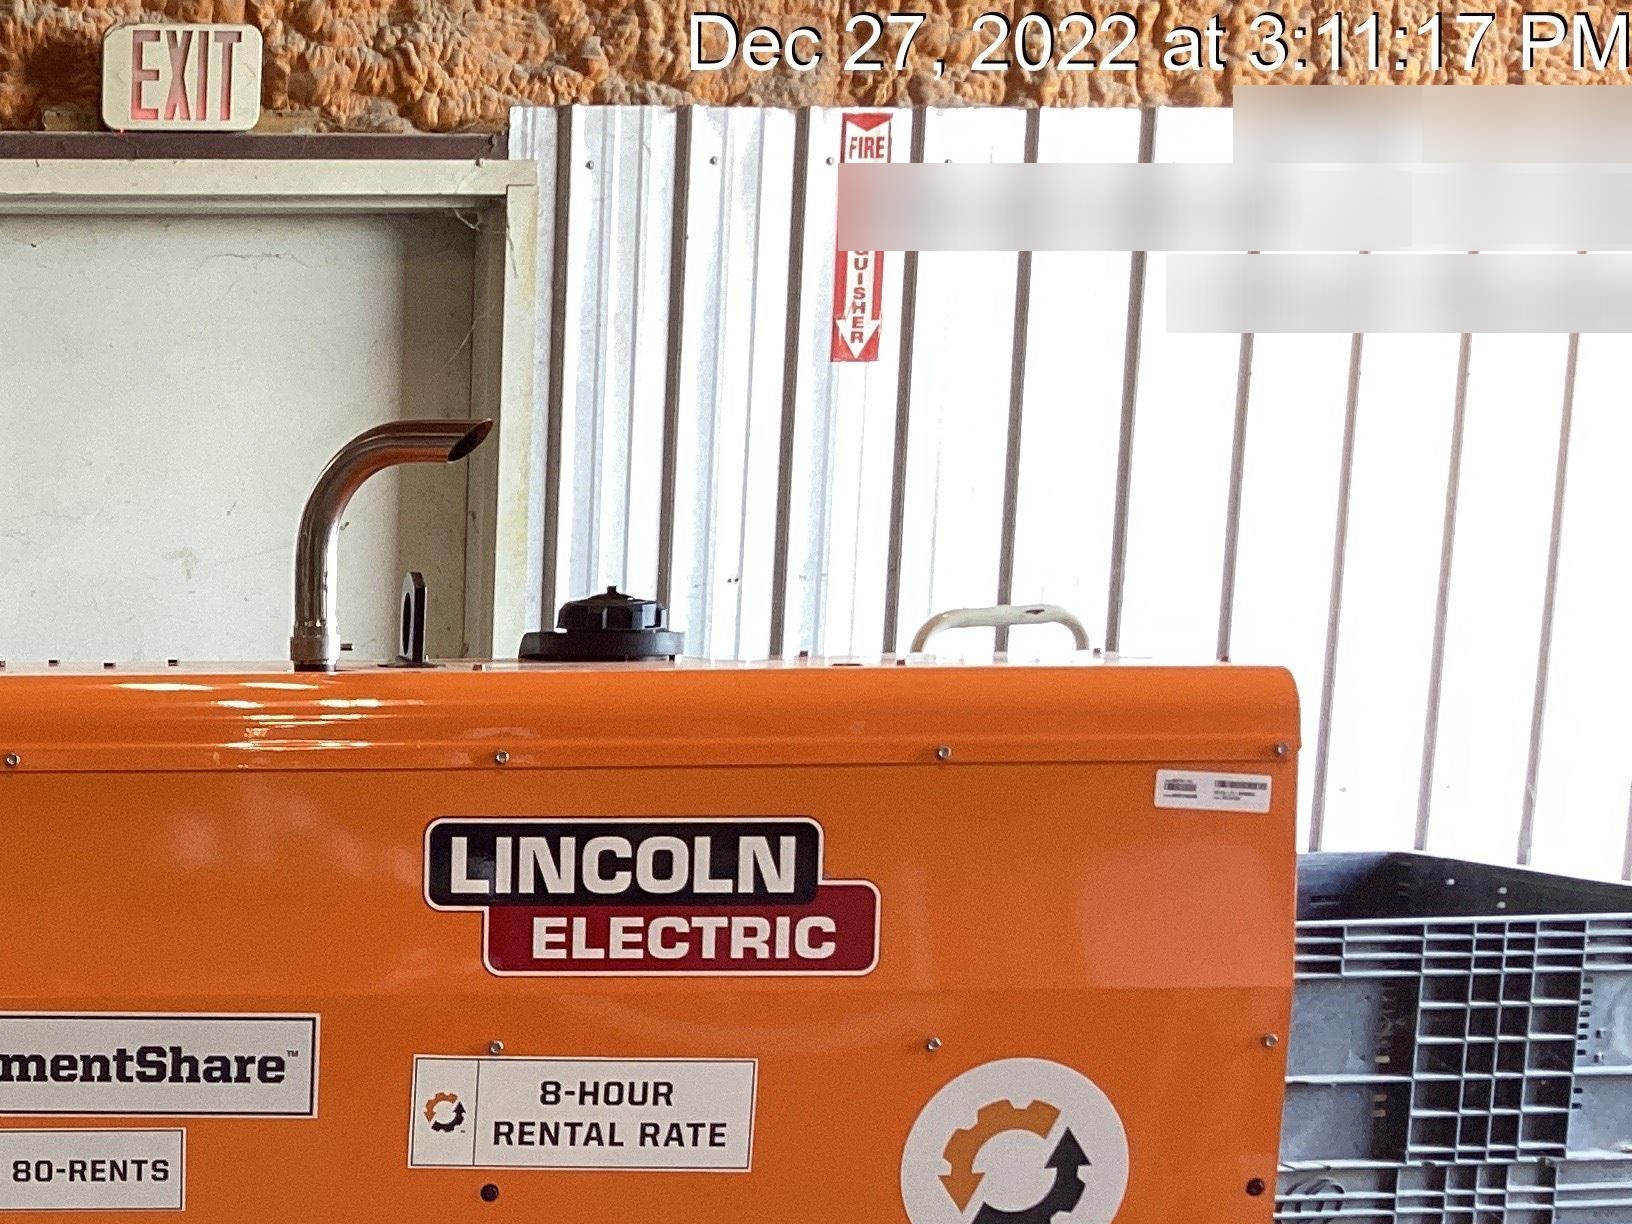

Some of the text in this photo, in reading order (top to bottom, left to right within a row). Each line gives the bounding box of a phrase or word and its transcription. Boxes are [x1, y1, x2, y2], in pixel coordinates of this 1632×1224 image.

[131, 30, 243, 121] EXIT
[848, 136, 886, 160] FIRE
[450, 835, 796, 895] LINCOLN
[532, 916, 837, 960] ELECTRIC
[539, 1080, 674, 1107] 8-HOUR
[492, 1121, 728, 1148] RENTAL RATE
[12, 1158, 170, 1183] 80-RENTS
